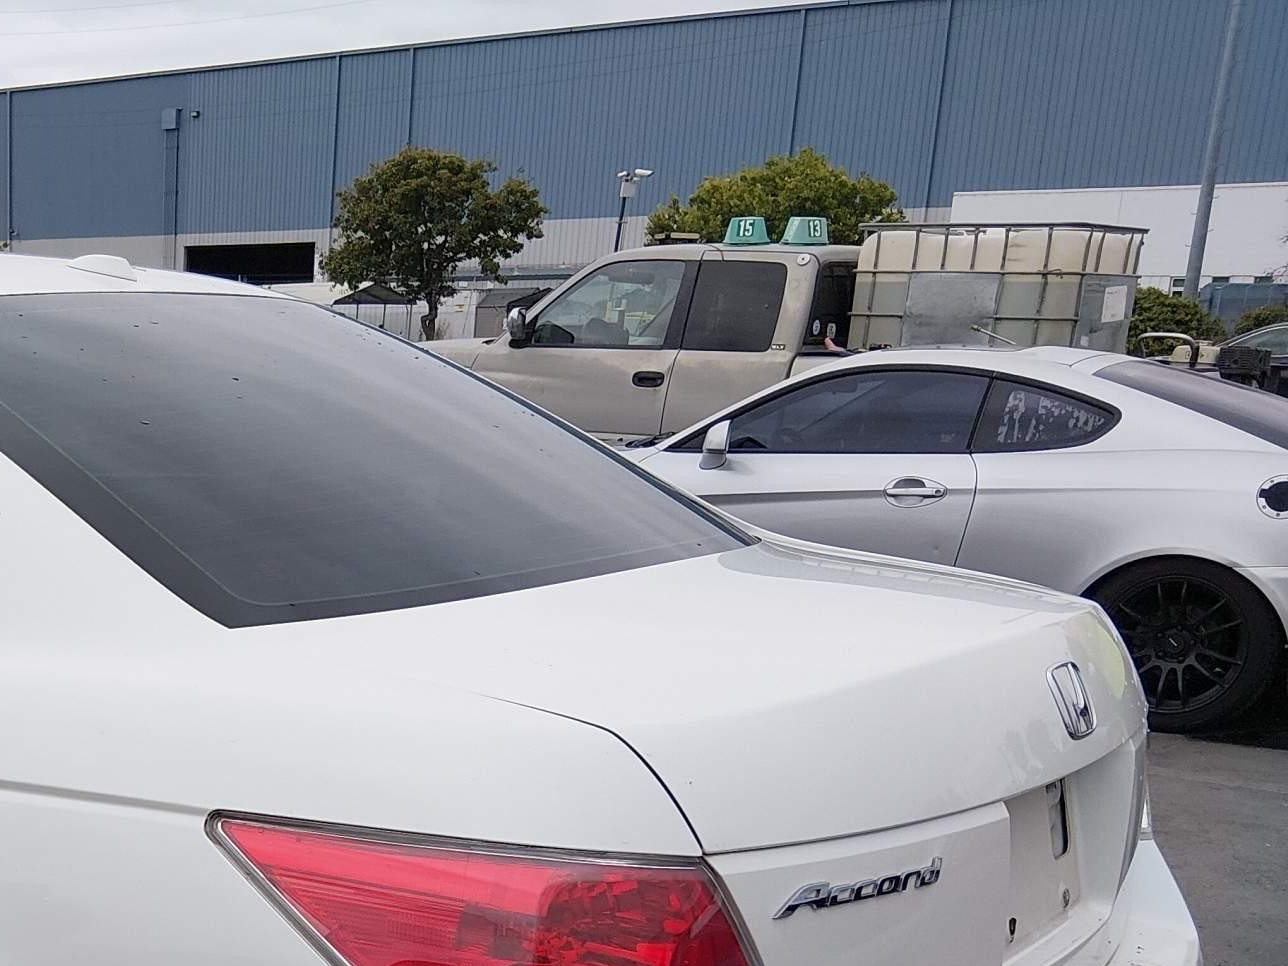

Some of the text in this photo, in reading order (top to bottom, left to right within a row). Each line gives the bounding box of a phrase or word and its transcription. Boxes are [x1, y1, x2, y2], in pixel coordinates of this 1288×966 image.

[738, 219, 755, 237] 15
[809, 219, 822, 237] 13
[768, 855, 943, 920] Accord
